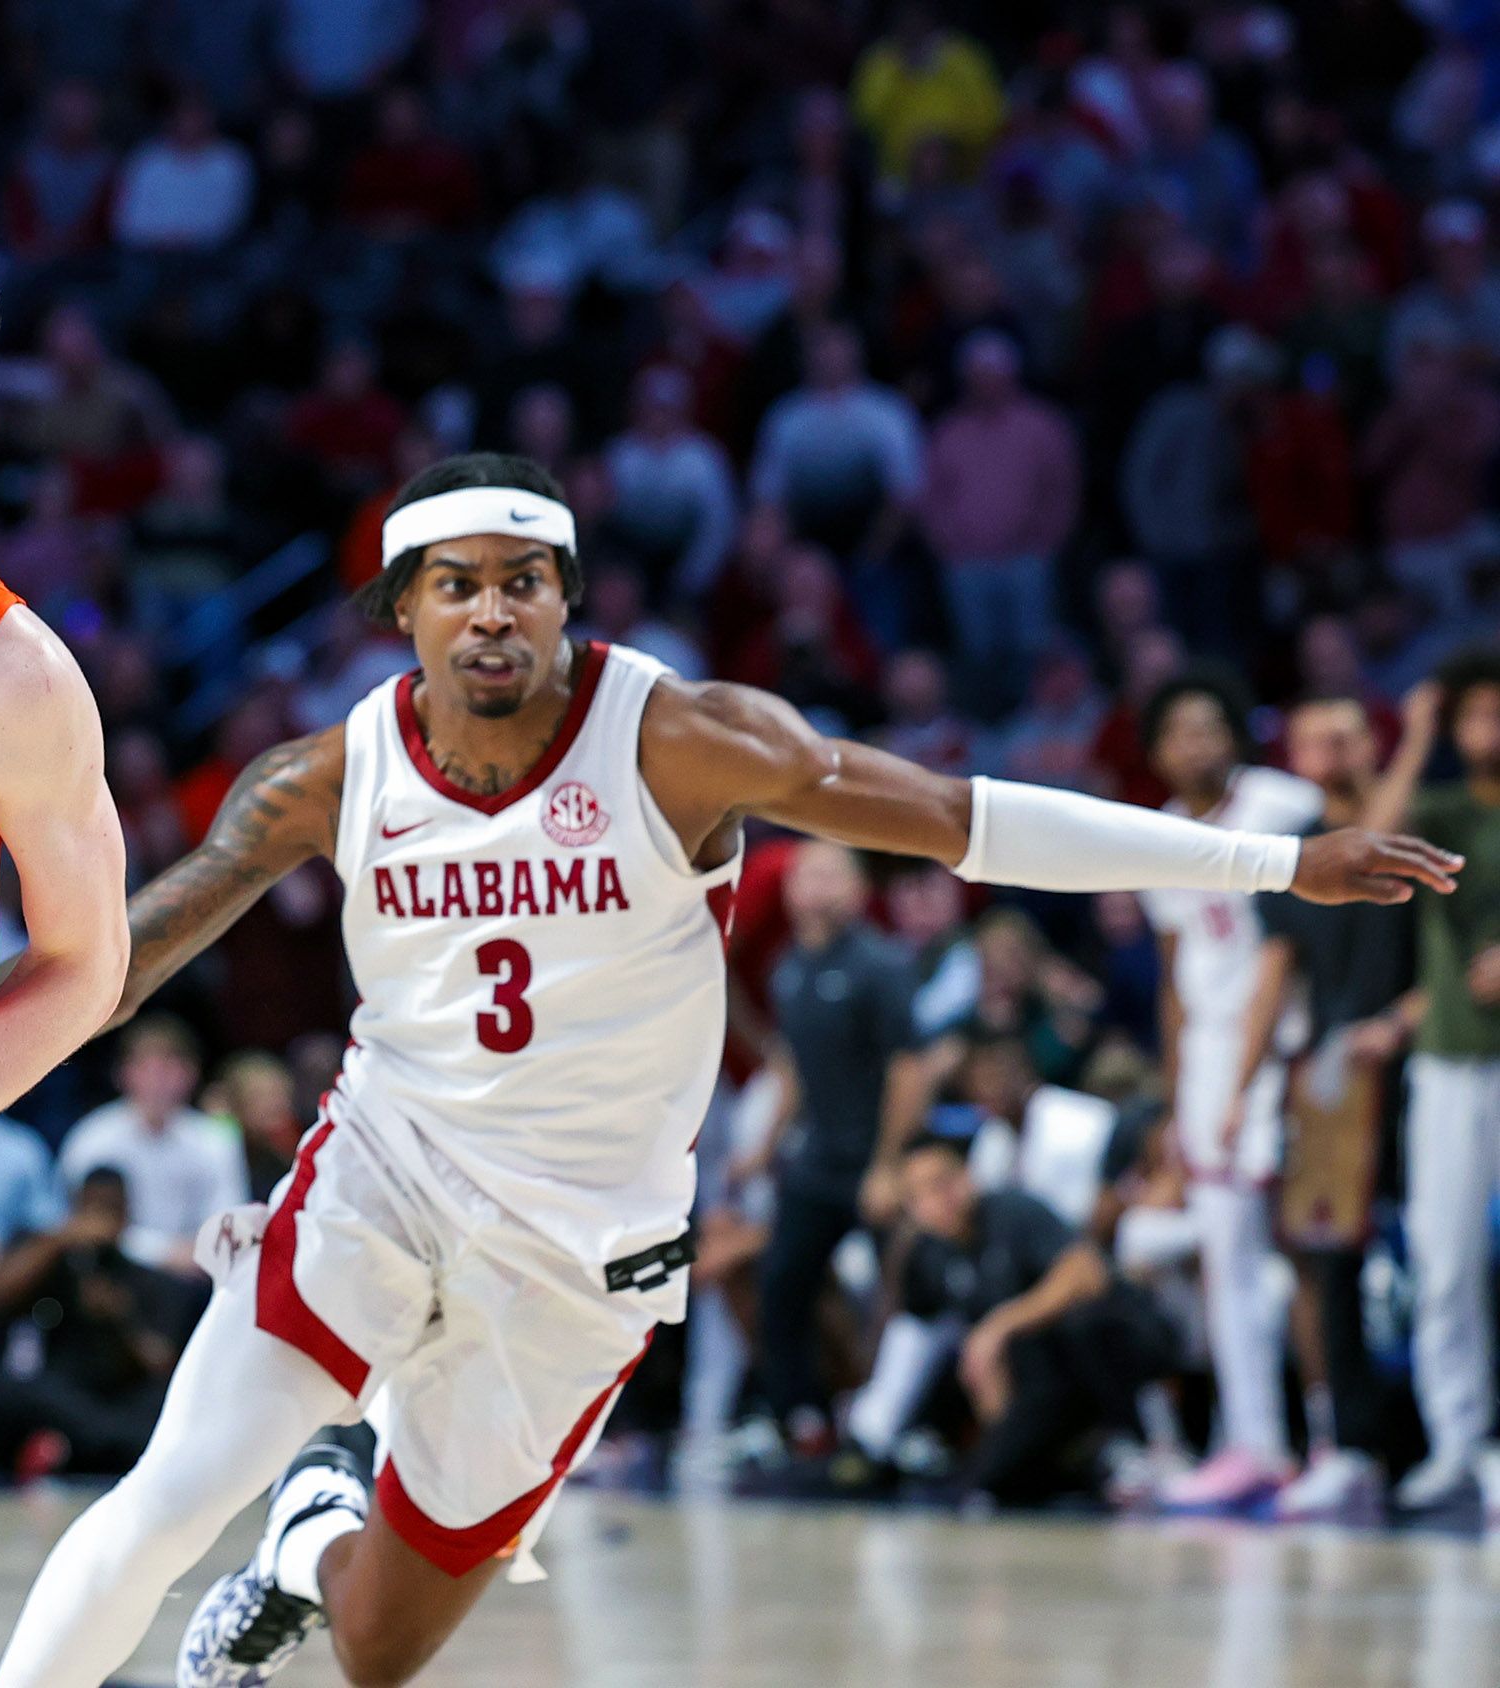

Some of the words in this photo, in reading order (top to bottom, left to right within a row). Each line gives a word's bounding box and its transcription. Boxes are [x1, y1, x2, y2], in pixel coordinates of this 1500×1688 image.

[552, 785, 599, 831] SEC
[374, 858, 630, 918] ALABAMA
[475, 938, 534, 1053] 3
